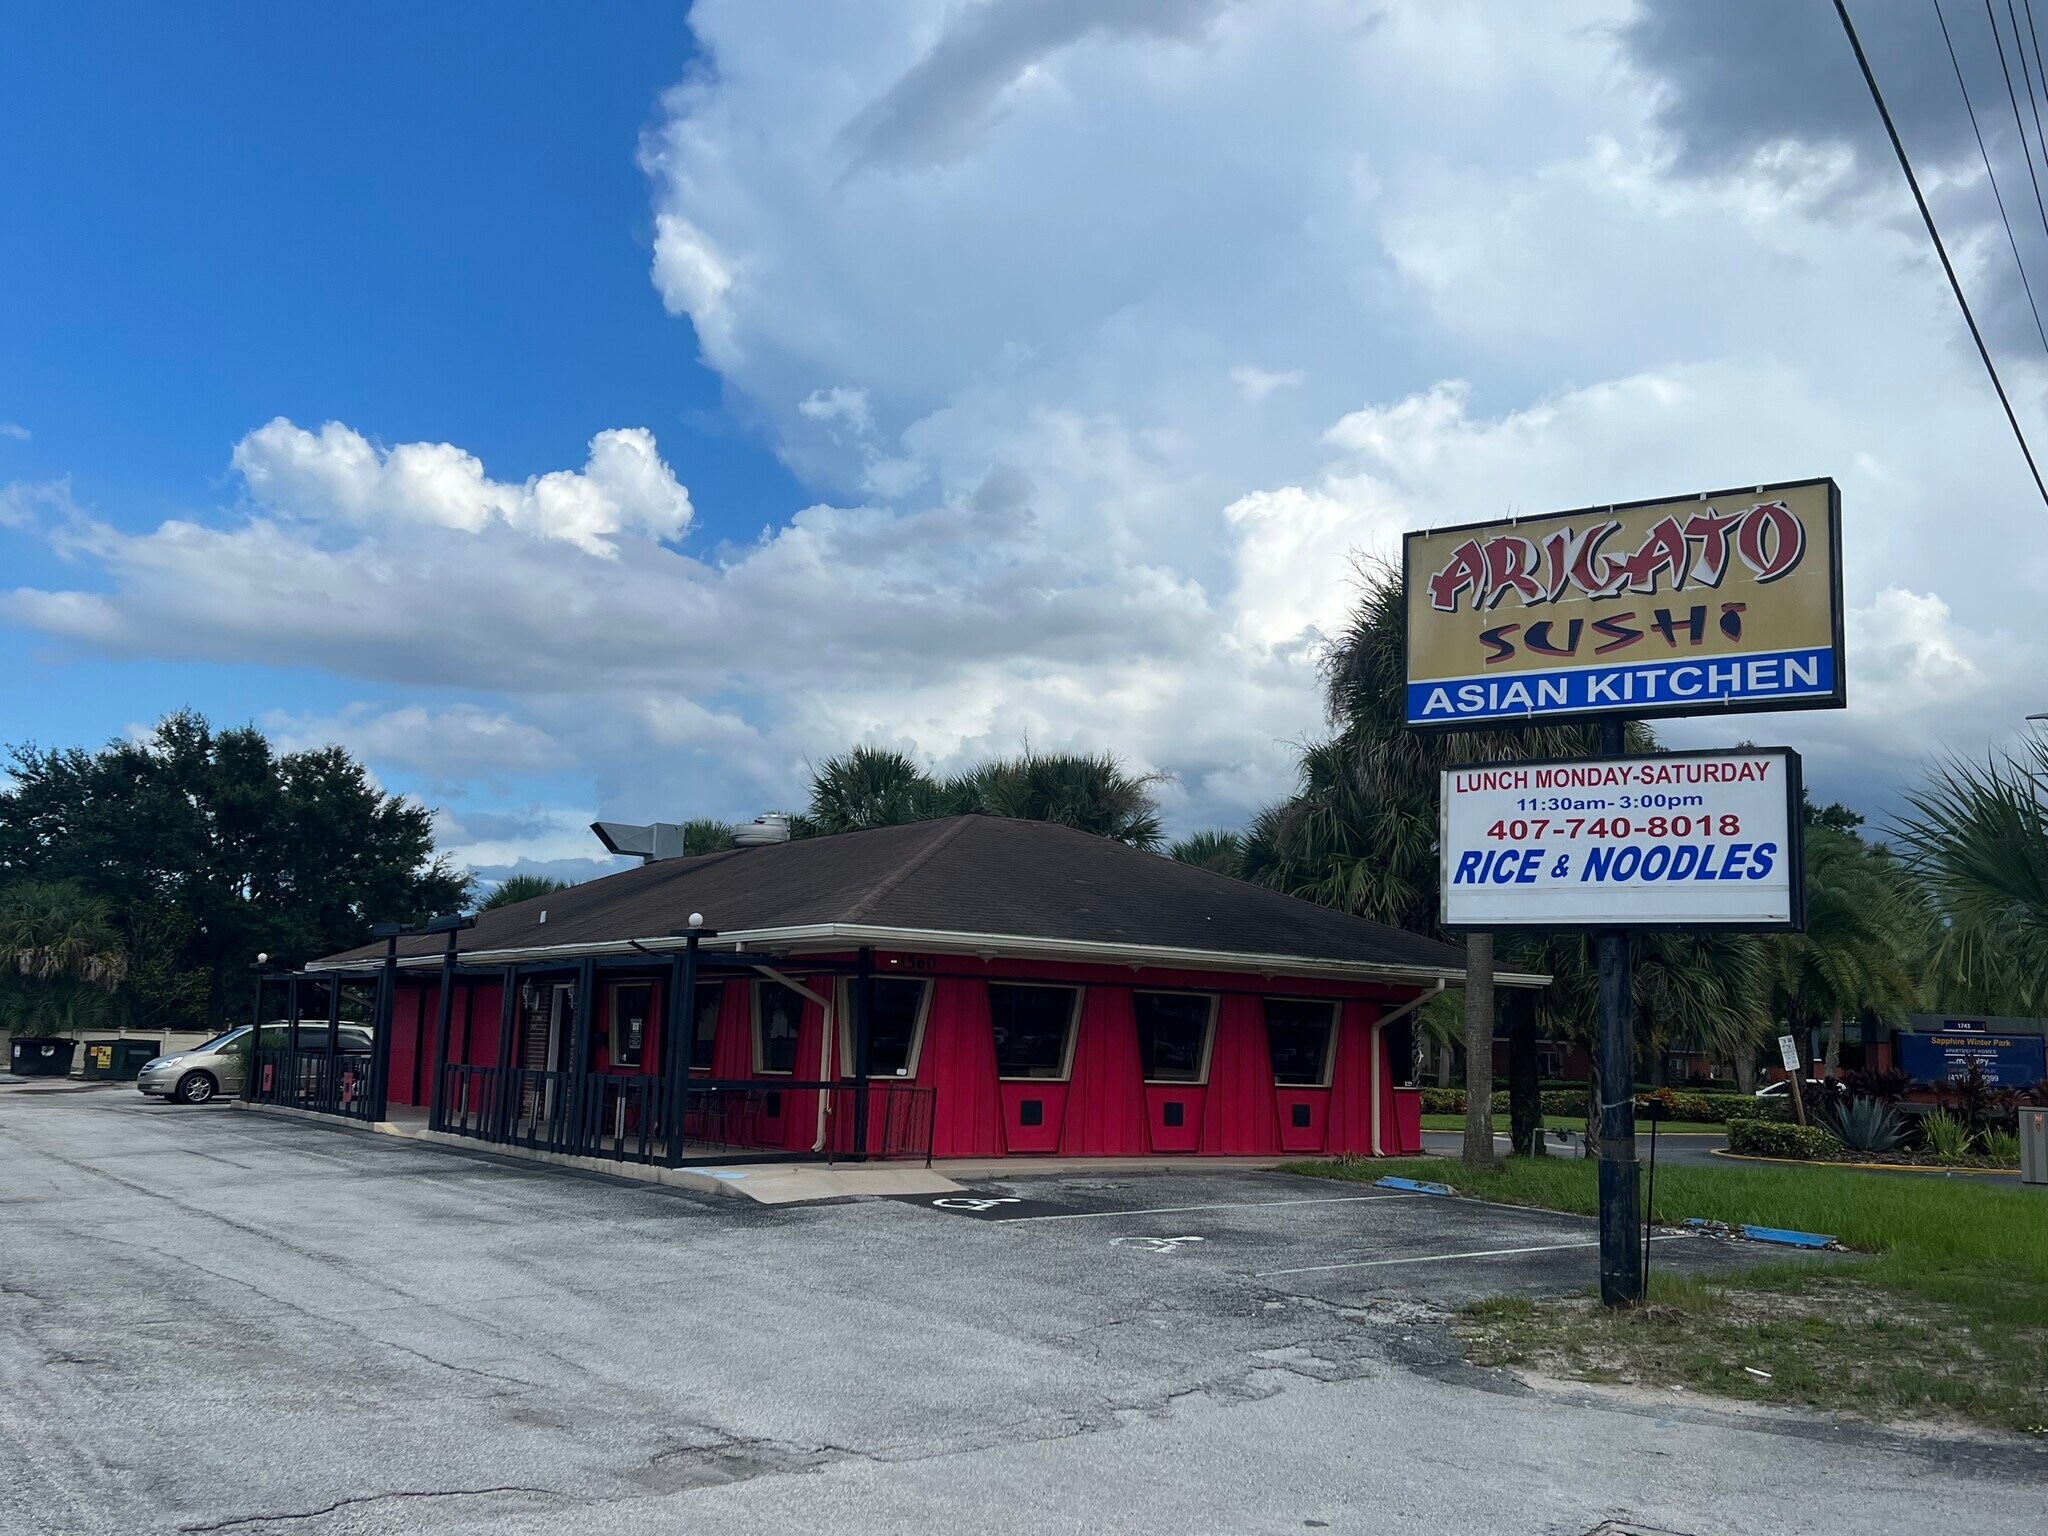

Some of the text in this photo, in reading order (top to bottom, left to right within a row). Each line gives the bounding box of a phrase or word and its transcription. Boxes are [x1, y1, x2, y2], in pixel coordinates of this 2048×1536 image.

[1426, 499, 1806, 613] ARIGATO
[1421, 655, 1819, 716] ASIAN KITCHEN
[1456, 761, 1771, 793] LUNCH MONDAY-SATURDAY
[1487, 814, 1741, 840] 407-740-8018
[1453, 842, 1777, 884] RICE & NOODLES
[1931, 1036, 1965, 1046] Sapphire
[1966, 1038, 1992, 1046] Winter
